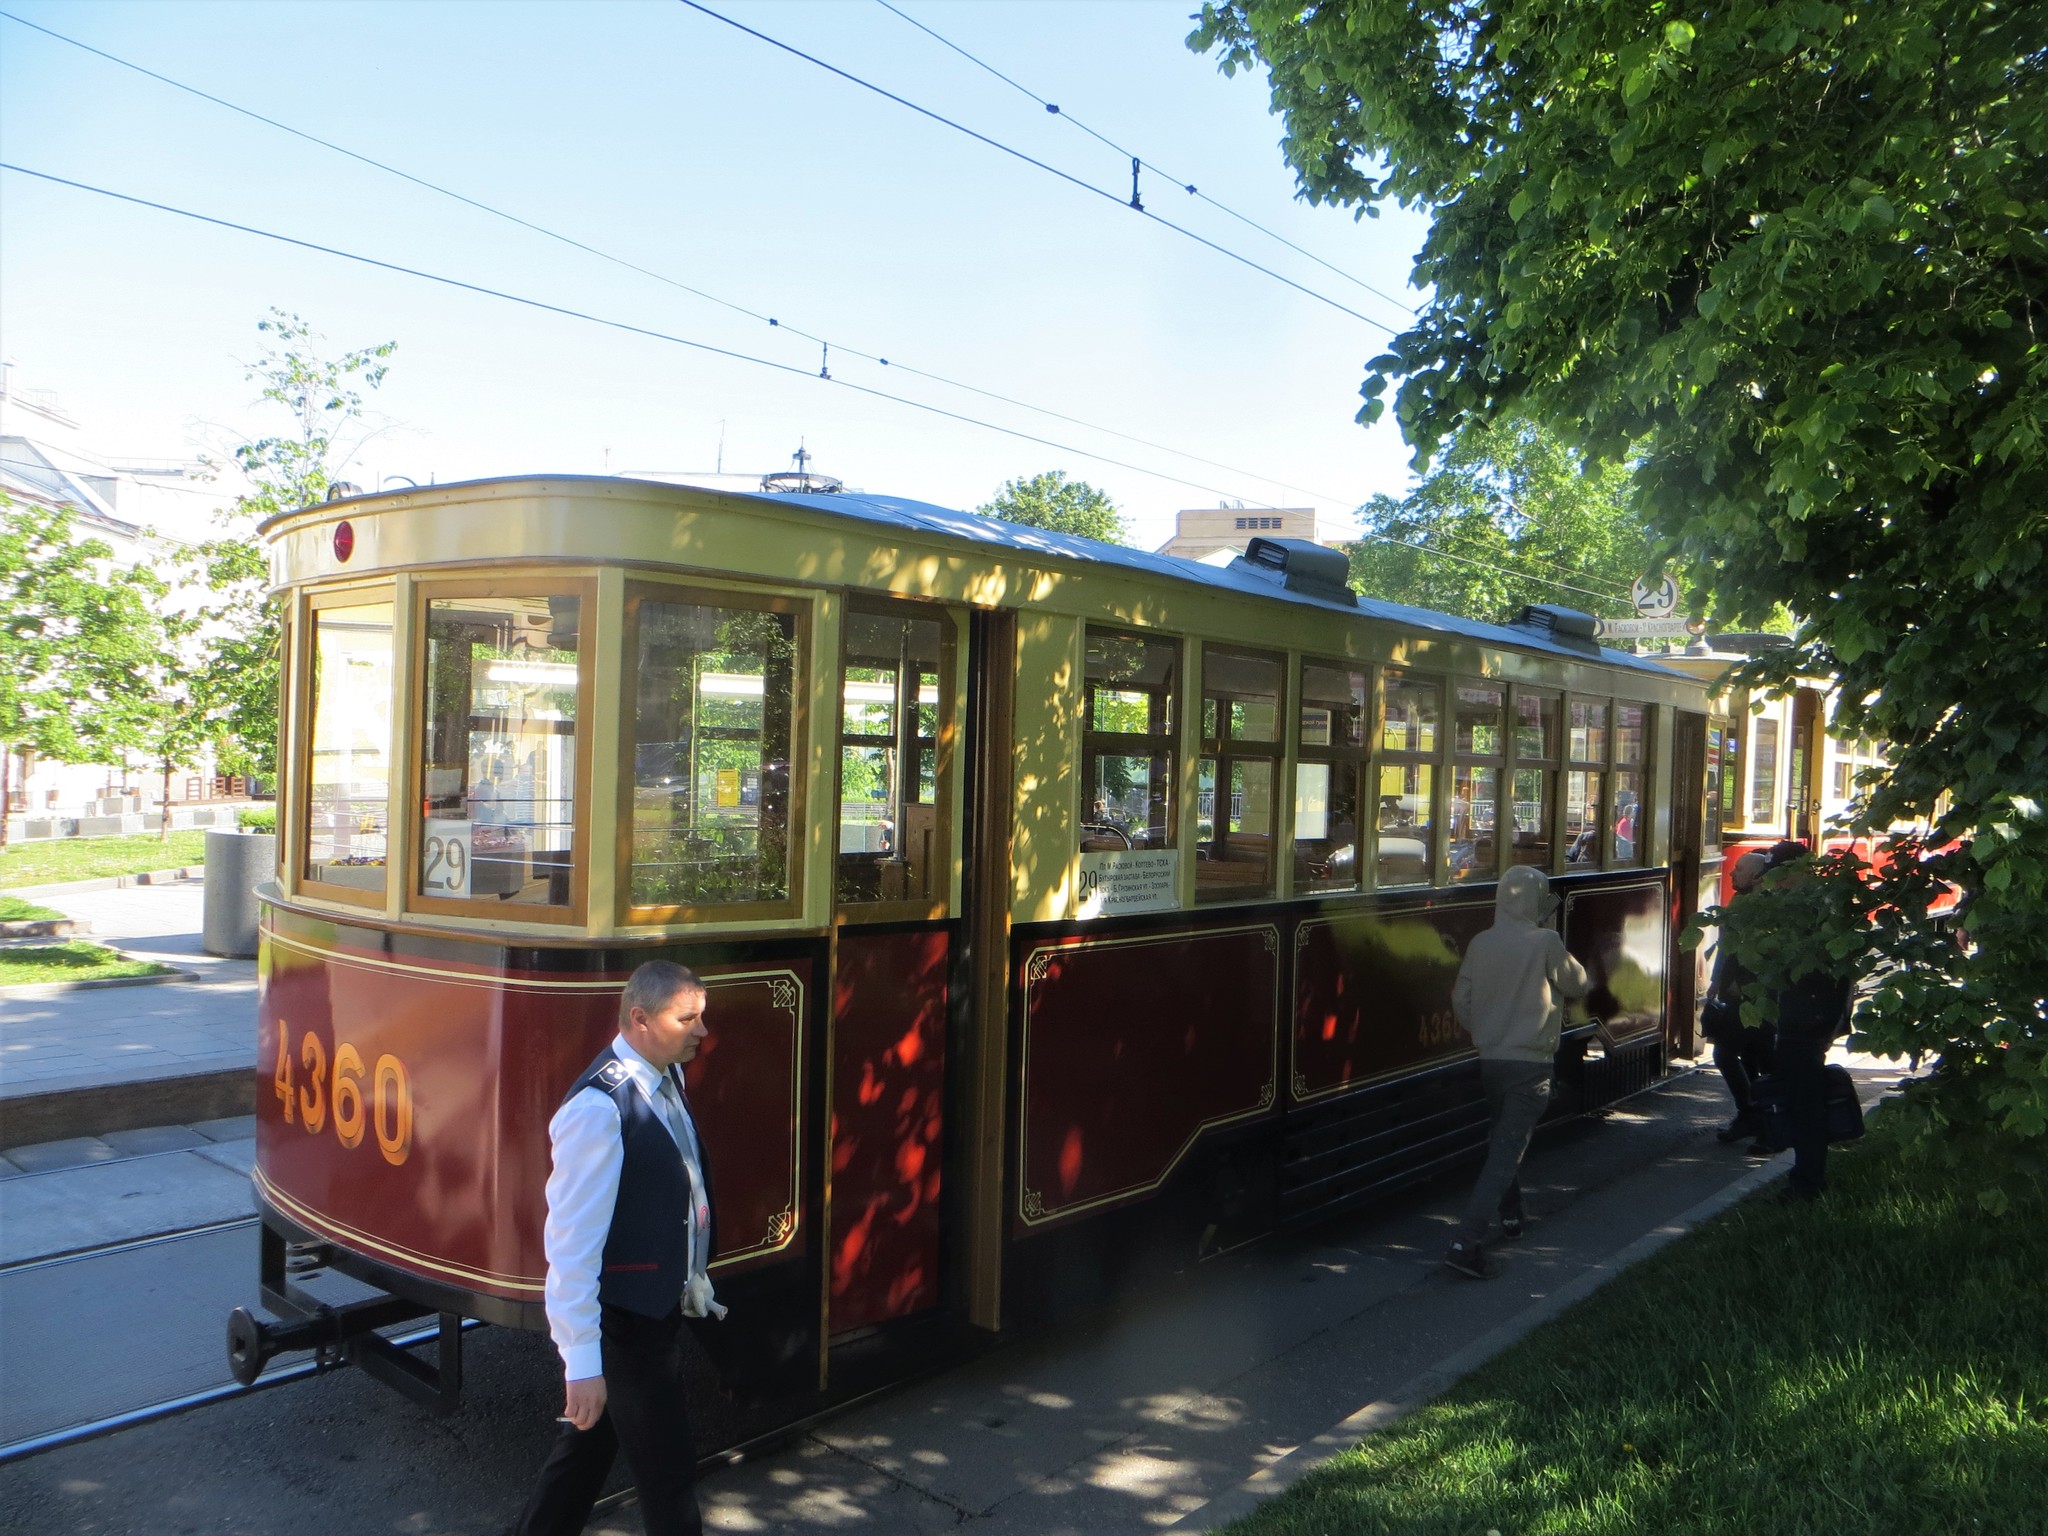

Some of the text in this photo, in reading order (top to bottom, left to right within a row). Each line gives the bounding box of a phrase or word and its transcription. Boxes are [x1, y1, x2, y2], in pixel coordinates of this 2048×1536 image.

[1637, 579, 1673, 609] 29
[424, 837, 465, 890] 29
[1079, 871, 1097, 901] 29
[275, 1019, 413, 1166] 4360
